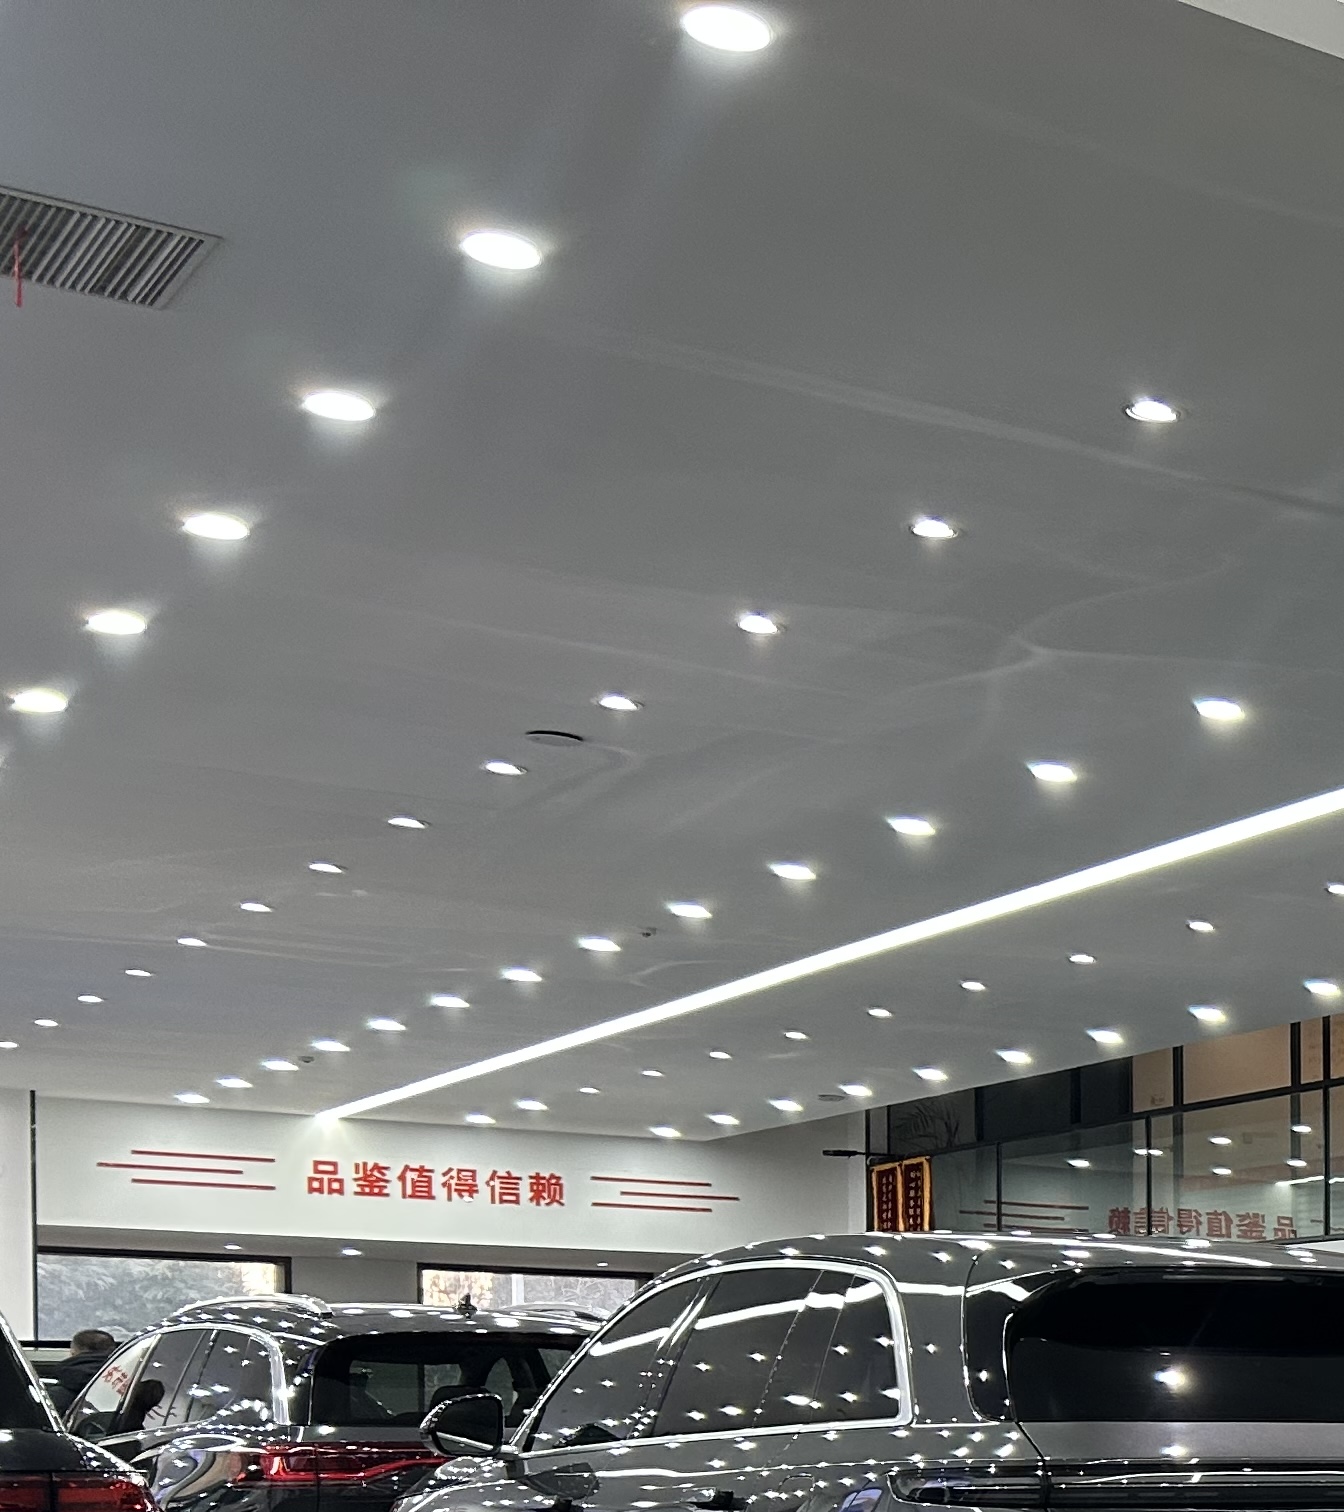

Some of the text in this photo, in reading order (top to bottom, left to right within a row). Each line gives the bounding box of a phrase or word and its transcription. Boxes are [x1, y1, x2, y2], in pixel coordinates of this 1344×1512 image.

[306, 1160, 567, 1206] 品鉴值得信赖
